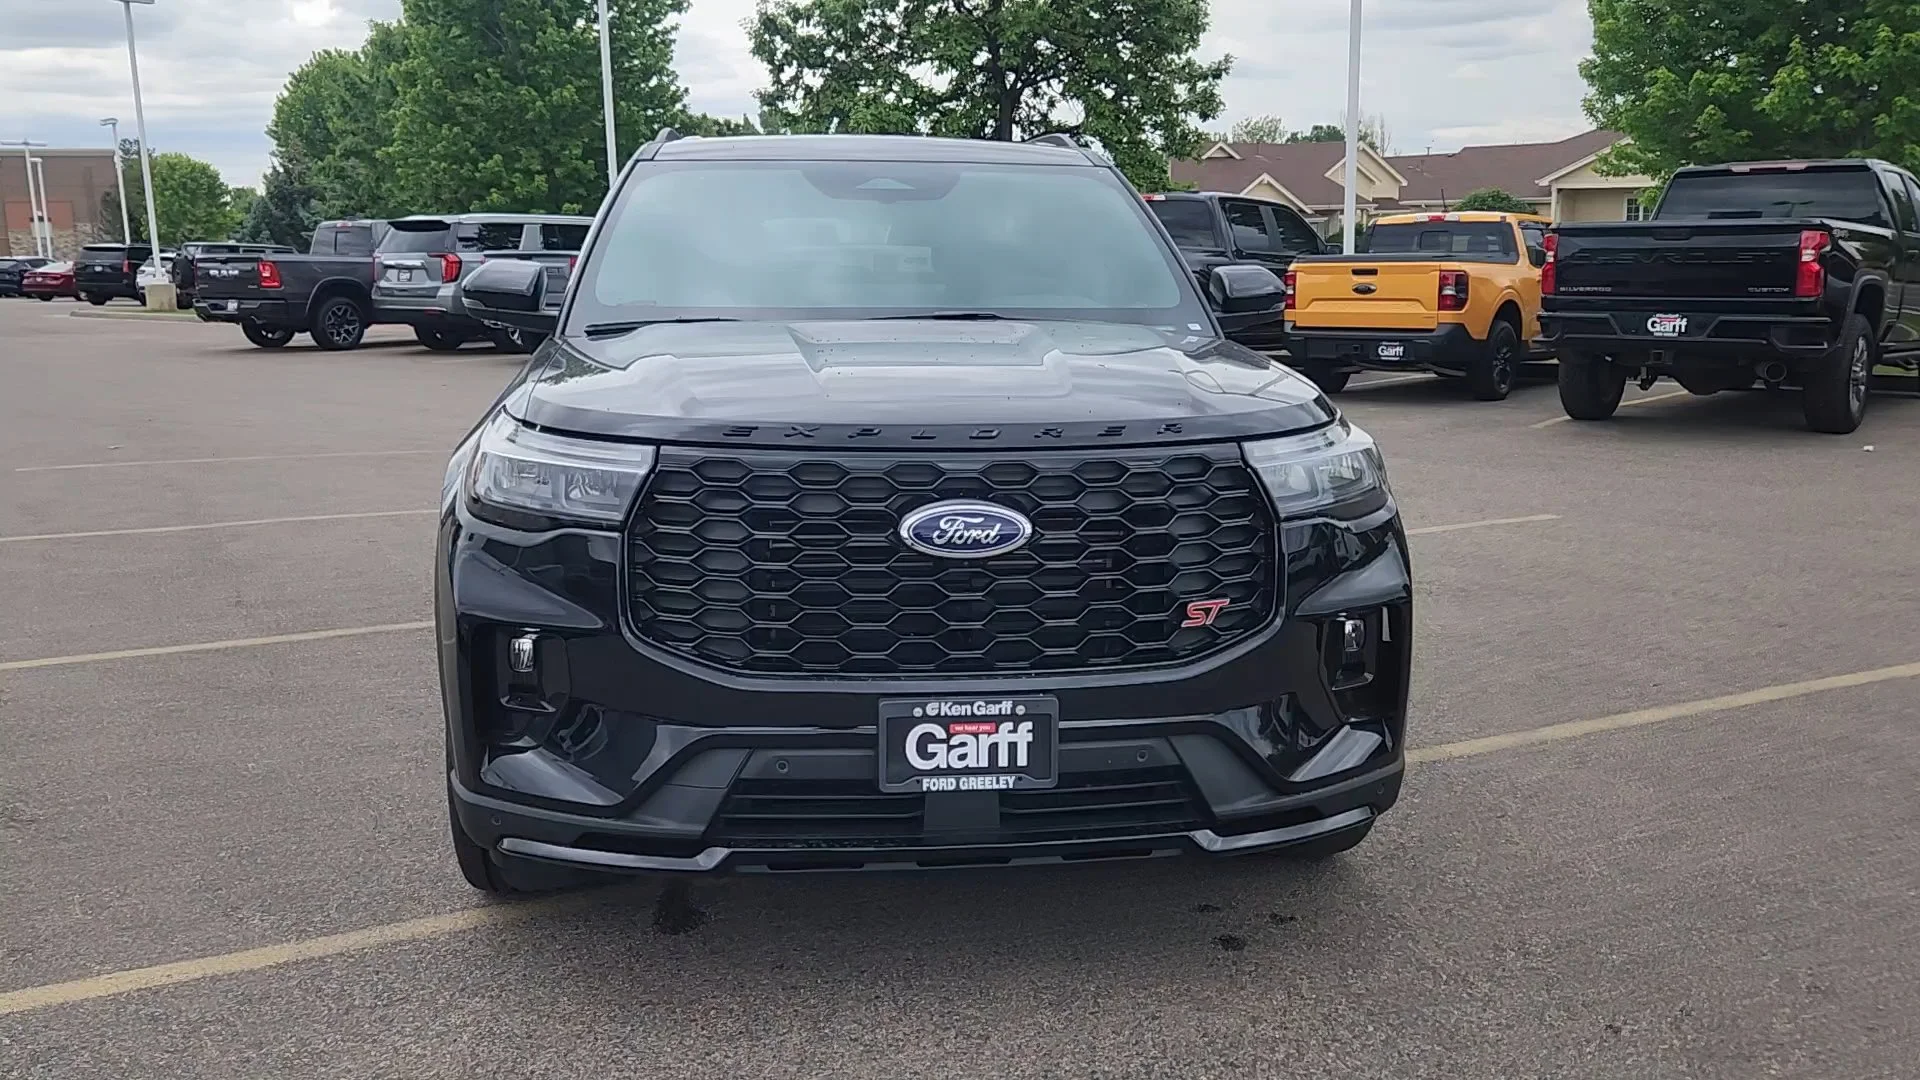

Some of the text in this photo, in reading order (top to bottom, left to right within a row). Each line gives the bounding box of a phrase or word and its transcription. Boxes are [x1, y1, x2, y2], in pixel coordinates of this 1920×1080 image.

[208, 269, 240, 278] RAM
[1646, 317, 1688, 333] Garff
[721, 423, 1185, 440] EXPLORER
[932, 515, 1002, 545] Ford
[1181, 598, 1230, 627] ST
[940, 701, 972, 717] Ken
[973, 700, 1013, 716] Garff
[905, 721, 1033, 770] Garff
[922, 775, 1016, 791] FORD GREELEY
